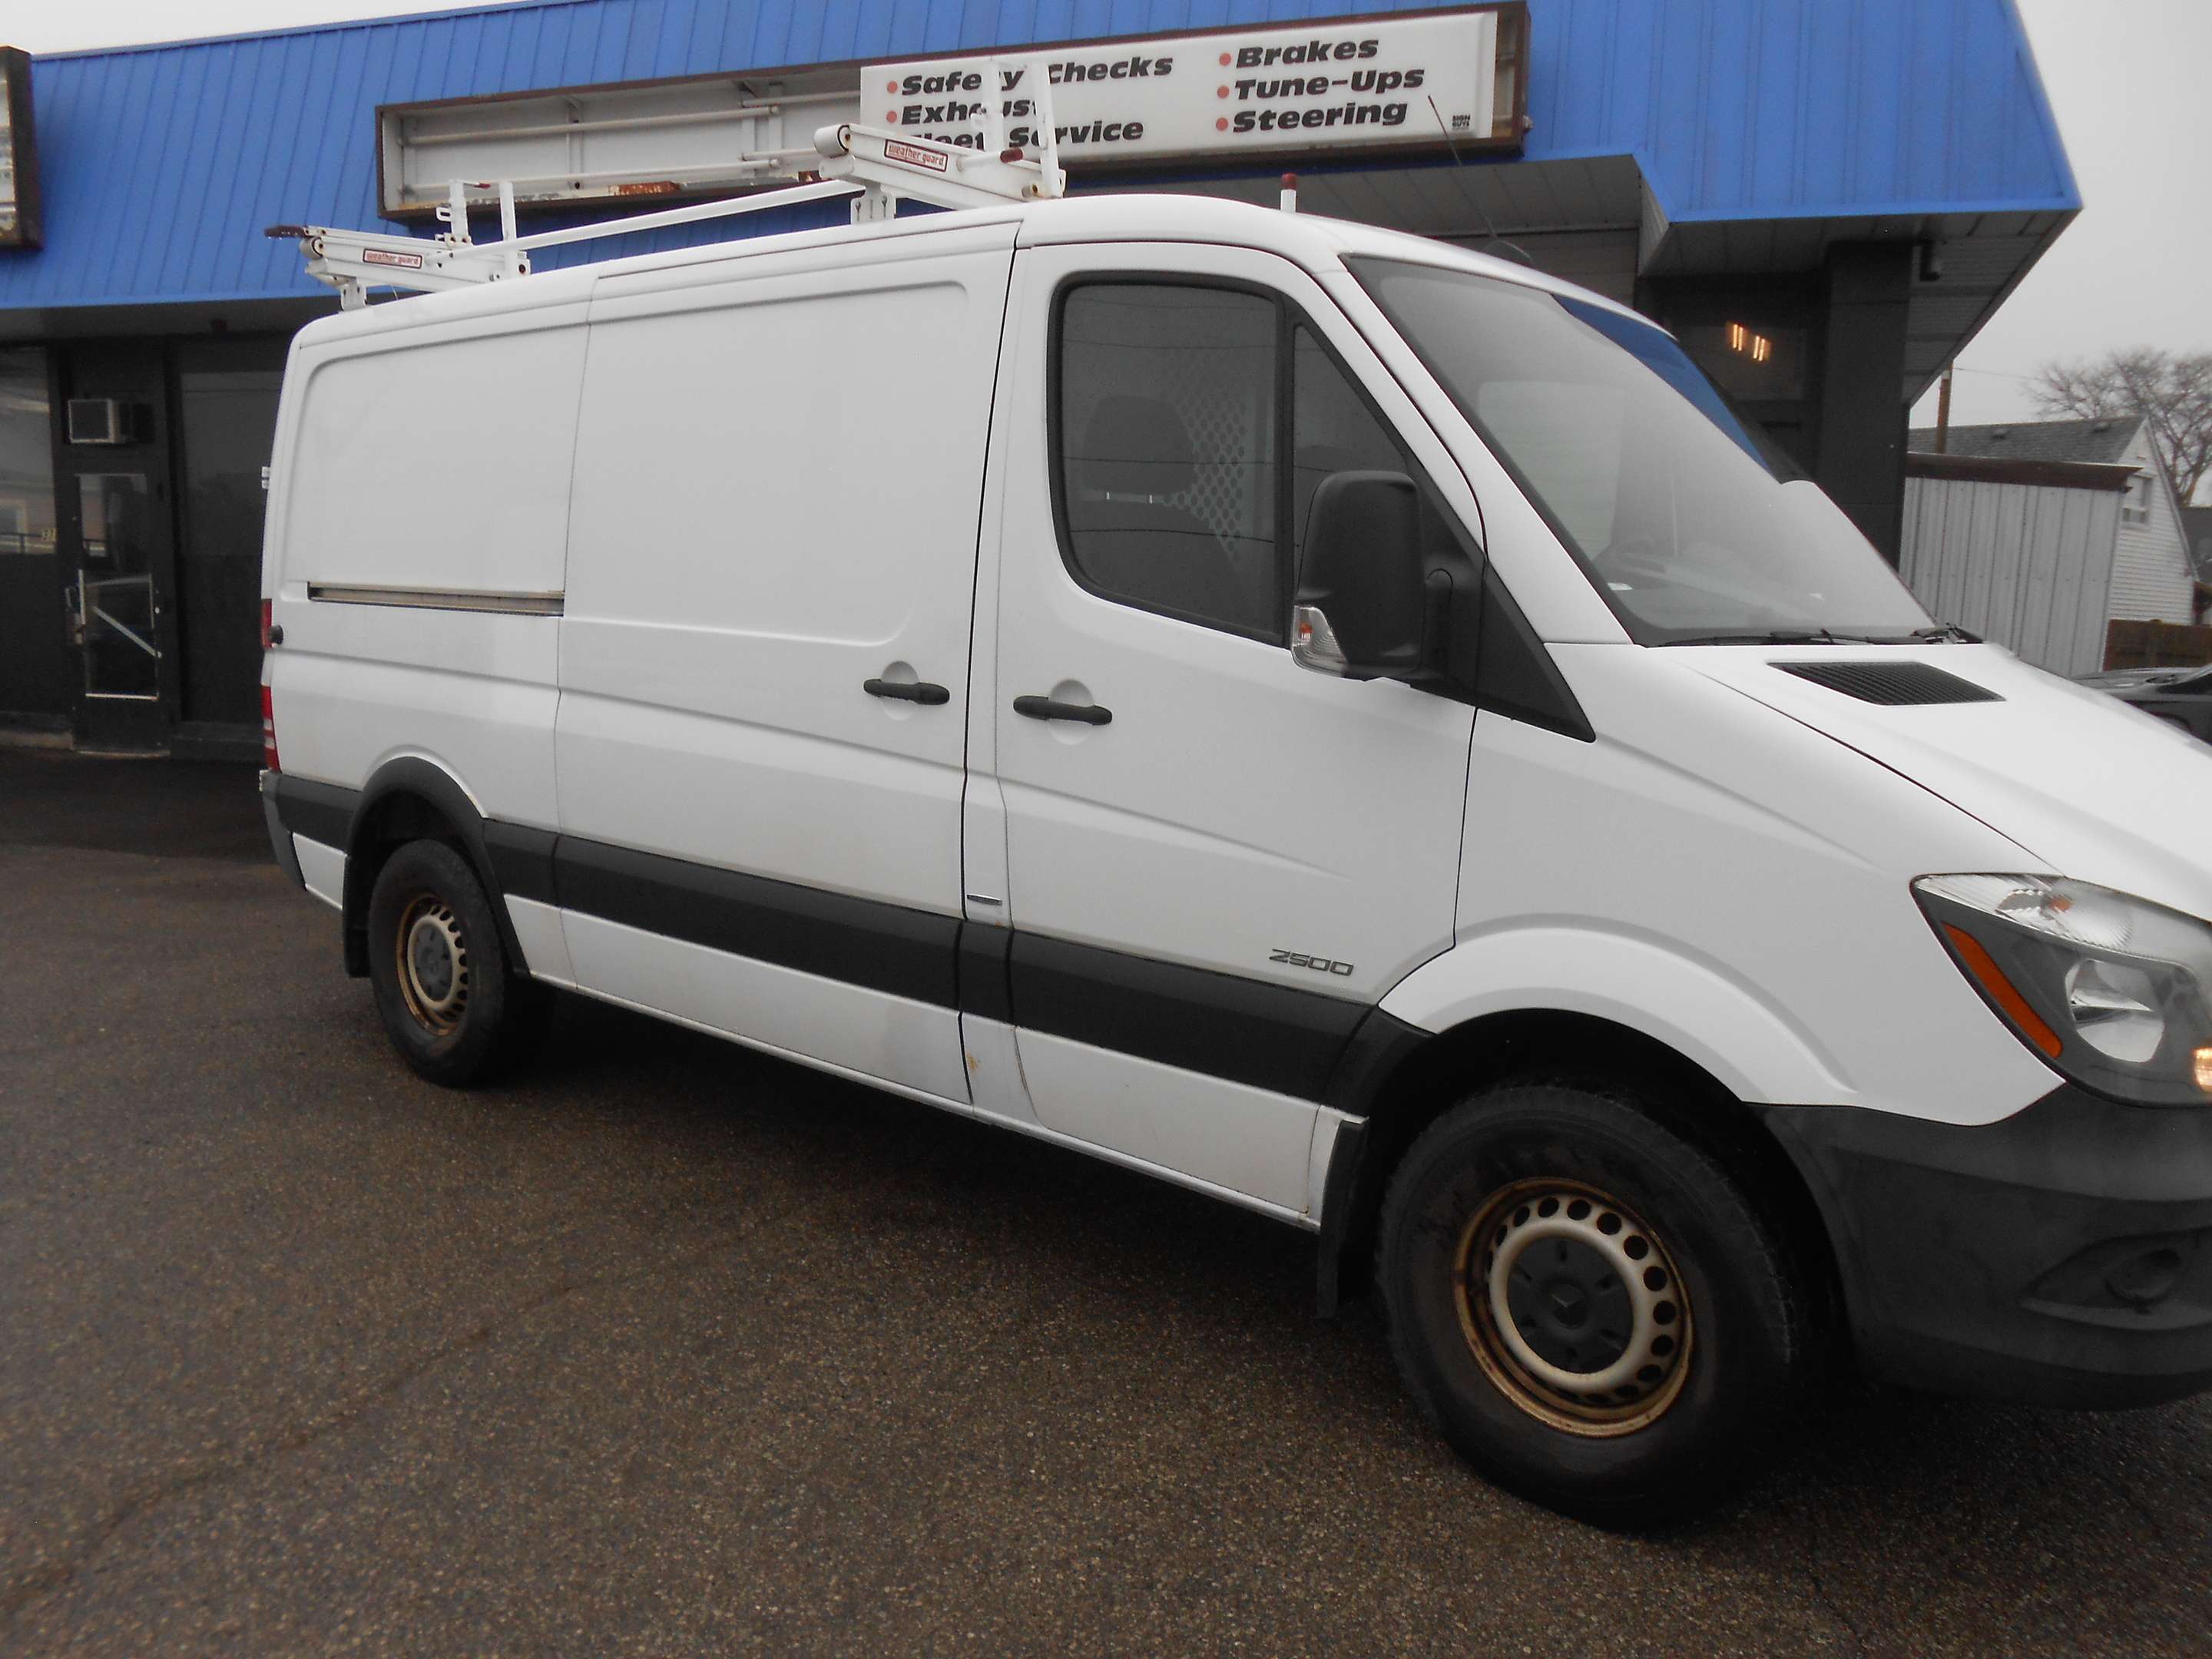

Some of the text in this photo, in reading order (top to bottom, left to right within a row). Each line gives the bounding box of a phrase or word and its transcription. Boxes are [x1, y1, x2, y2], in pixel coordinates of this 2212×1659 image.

[1236, 39, 1379, 68] Brakes
[902, 56, 1174, 96] Safey Checks
[1234, 68, 1425, 100] Tune-Ups
[1233, 101, 1408, 133] Steering
[1269, 949, 1354, 977] 2500
